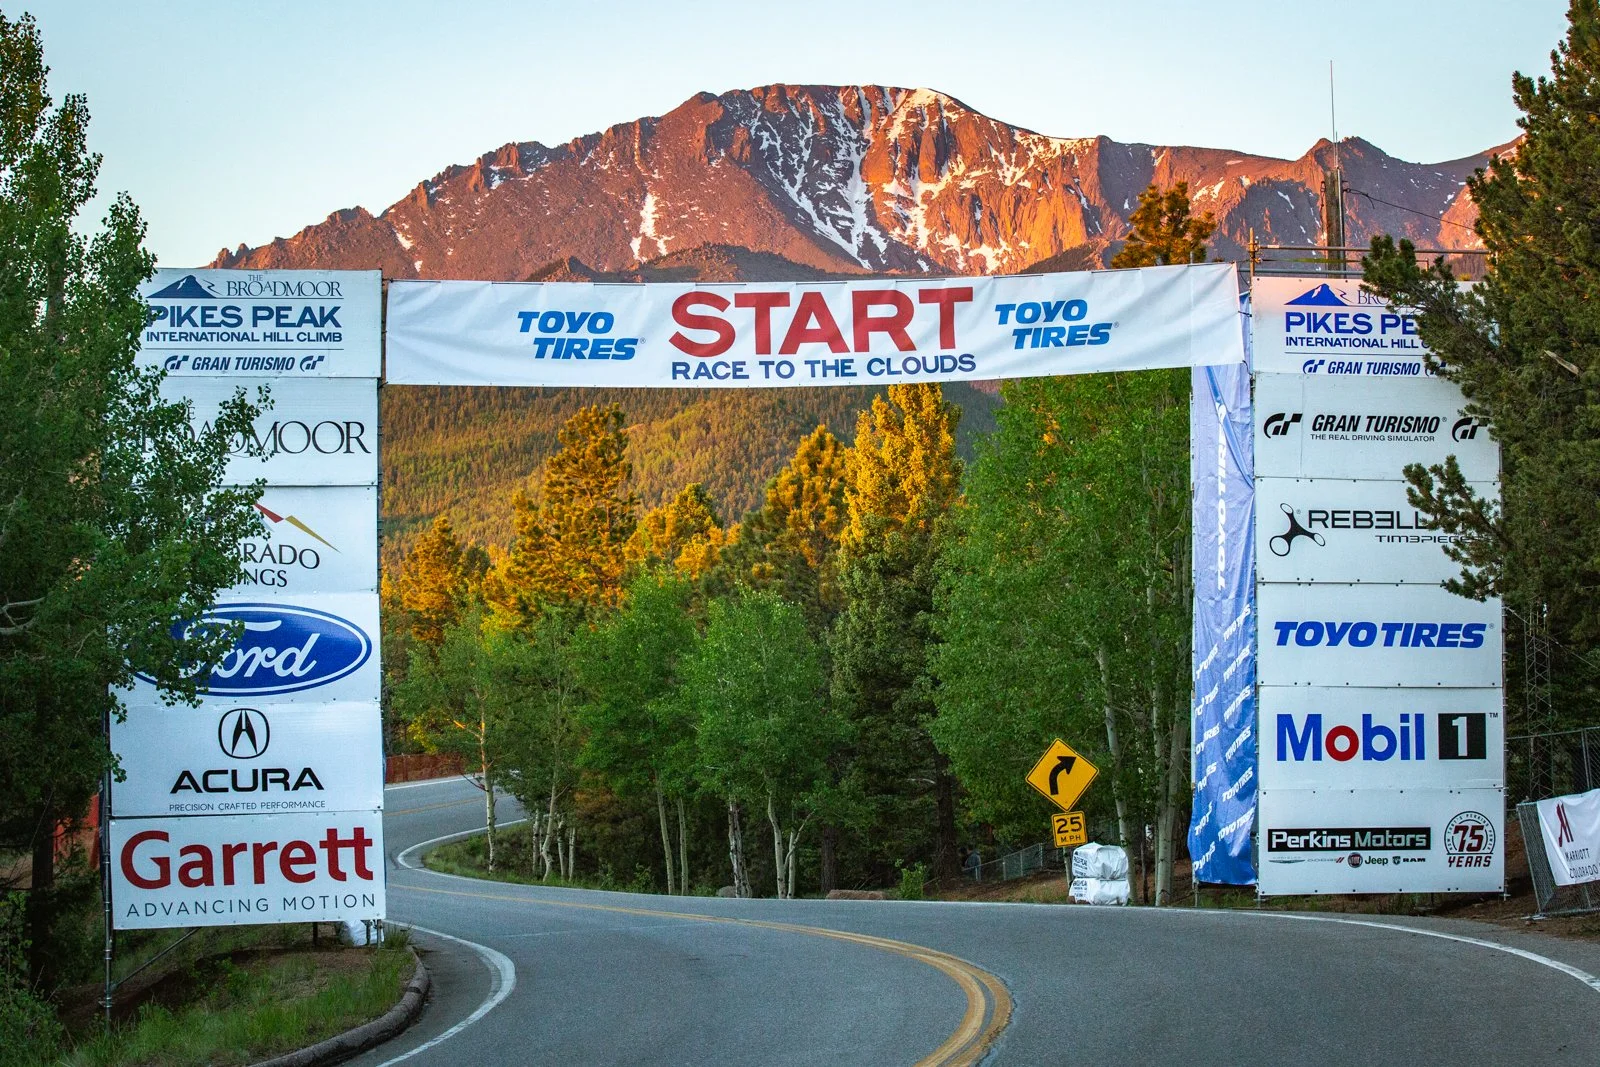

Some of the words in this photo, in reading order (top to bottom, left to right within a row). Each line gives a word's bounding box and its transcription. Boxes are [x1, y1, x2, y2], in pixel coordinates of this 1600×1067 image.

[226, 280, 342, 297] BROADMOOR
[147, 305, 243, 328] PIKES
[252, 305, 342, 328] PEAK
[517, 311, 614, 334] TOYO
[669, 287, 973, 357] START
[995, 299, 1088, 325] TOYO
[1285, 312, 1373, 335] PIKES
[1380, 314, 1420, 335] PE
[146, 331, 260, 342] INTERNATIONAL
[263, 332, 294, 342] HILL
[296, 332, 342, 342] CLIMB
[1012, 322, 1113, 349] TIRES
[1285, 337, 1388, 349] INTERNATIONAL
[1391, 338, 1419, 349] HILL
[533, 337, 639, 360] TIRES
[191, 357, 230, 371] GRAN
[234, 357, 295, 371] TURISMO
[672, 361, 749, 380] RACE
[759, 360, 795, 379] TO
[804, 357, 857, 378] THE
[866, 353, 977, 376] CLOUDS
[1327, 361, 1362, 374] GRAN
[1366, 362, 1420, 375] TURISMO
[1311, 414, 1361, 432] GRAN
[1365, 416, 1440, 433] TURISMO
[1310, 433, 1327, 441] THE
[1352, 434, 1386, 442] DRIVING
[1274, 621, 1377, 647] TOYO
[1381, 622, 1487, 649] TIRES
[1276, 713, 1425, 762] Mobil
[170, 767, 324, 794] ACURA
[170, 803, 214, 812] PRECISION
[218, 802, 257, 811] CRAFTED
[261, 801, 325, 810] PERFORMANCE
[1056, 816, 1083, 834] 25
[1271, 830, 1351, 848] Perkins
[1354, 829, 1427, 848] Motors
[1453, 825, 1484, 852] 75
[120, 827, 374, 890] Garrett
[1365, 855, 1389, 866] Jeep
[1448, 855, 1492, 868] YEARS
[127, 898, 269, 917] ADVANCING
[283, 894, 375, 911] MOTION
